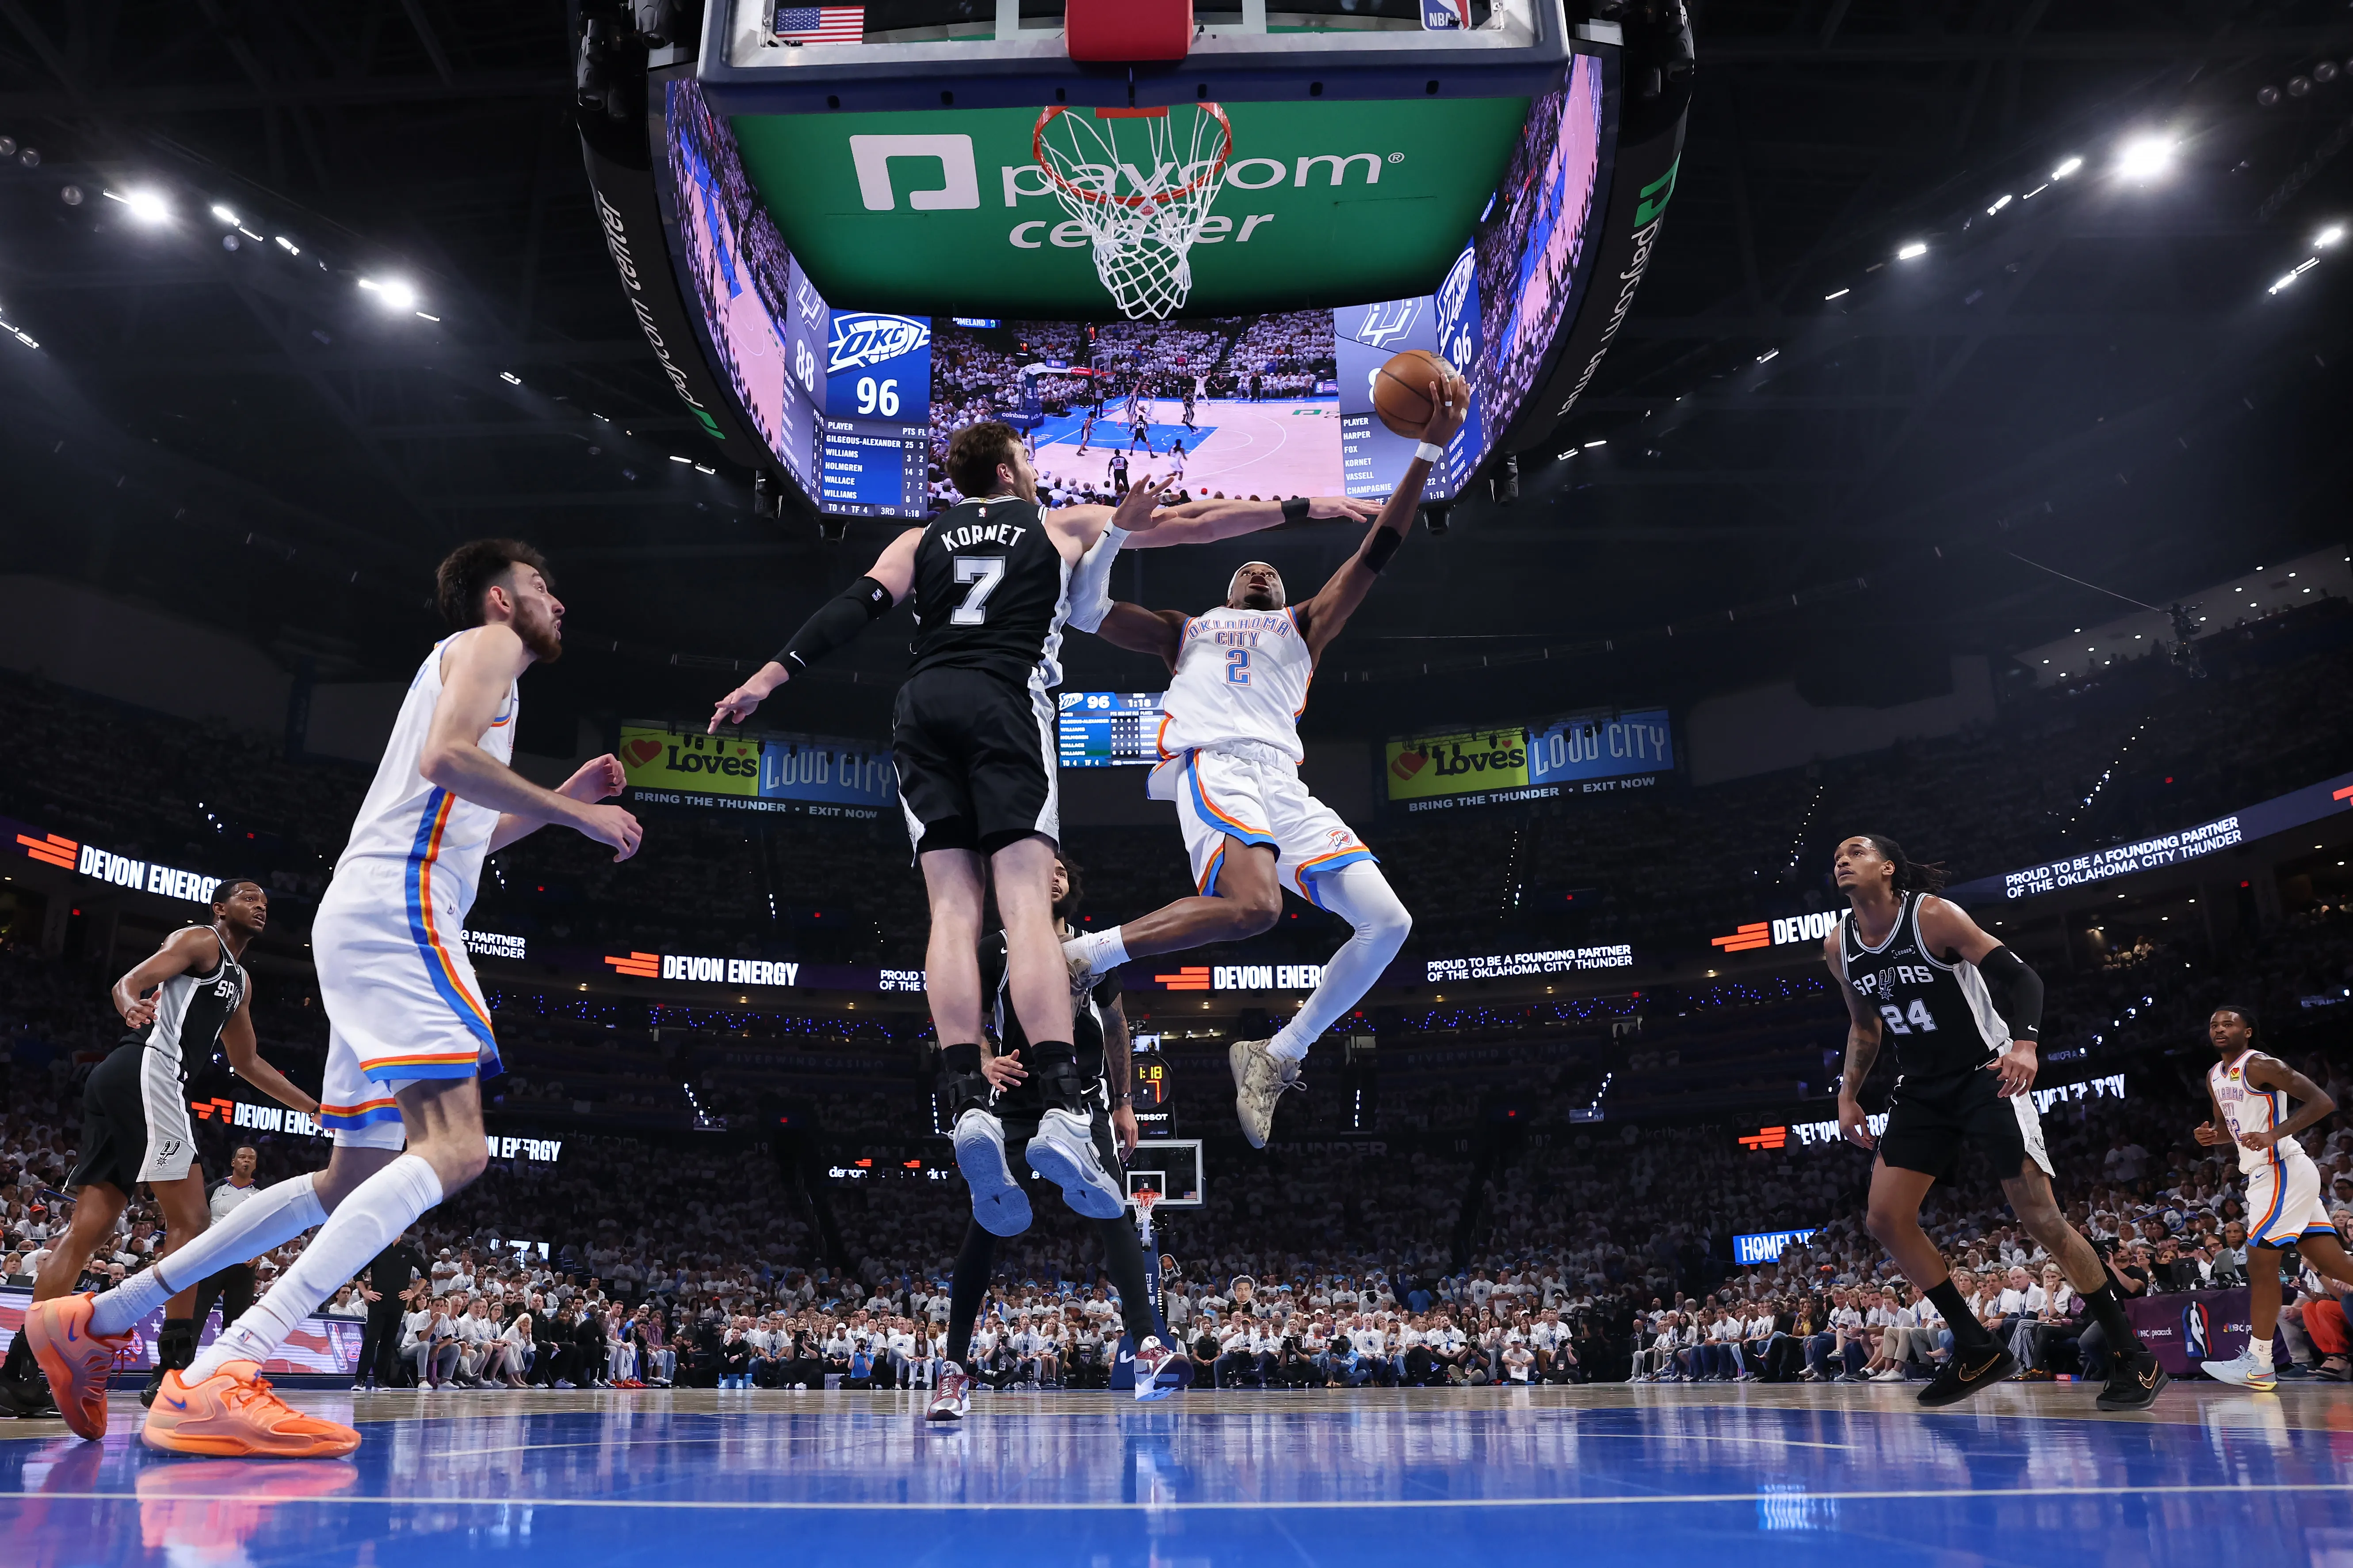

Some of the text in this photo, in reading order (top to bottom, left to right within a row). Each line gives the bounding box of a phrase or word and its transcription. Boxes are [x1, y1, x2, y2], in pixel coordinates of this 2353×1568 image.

[598, 191, 703, 408] paycom center
[1557, 218, 1660, 416] paycom center
[1453, 322, 1472, 376] 96
[796, 339, 814, 392] 88
[856, 377, 900, 416] 96
[828, 421, 853, 431] PLAYER
[1343, 417, 1369, 427] PLAYER
[826, 435, 901, 448] GILGEOUS-ALEXANDER
[1343, 431, 1371, 440] HARPER
[825, 448, 858, 458] WILLIAMS
[1344, 445, 1358, 454] FOX
[825, 462, 863, 472] HOLMGREN
[1345, 458, 1371, 467] KORNET
[825, 475, 855, 485] WALLACE
[1346, 471, 1374, 481] VASSELL
[824, 489, 857, 499] WILLIAMS
[1347, 483, 1392, 495] CHAMPAGNIE
[1427, 477, 1436, 486] 22
[1429, 490, 1445, 500] 1:18
[828, 503, 837, 511] TO
[851, 505, 860, 514] TF
[881, 507, 895, 515] 3RD
[905, 509, 920, 518] 1:18
[941, 523, 1027, 552] KORNET
[950, 556, 1006, 625] 7
[1187, 615, 1291, 640] OKLAHOMA
[1215, 630, 1260, 647] CITY
[1225, 648, 1251, 686] 2
[1087, 695, 1110, 709] 96
[1127, 698, 1151, 708] 1:18
[1533, 726, 1598, 777] LOUD
[1608, 723, 1665, 762] CITY
[766, 751, 829, 790] LOUD
[839, 752, 891, 799] CITY
[1409, 776, 1655, 813] BRING THE THUNDER EXIT NOW
[634, 791, 878, 819] BRING THE THUNDER EXIT NOW
[1333, 832, 1347, 847] OKC
[2005, 816, 2240, 887] PROUD TO BE A FOUNDING PARTNER
[2007, 829, 2243, 899] OF THE OKLAHOMA CITY THUNDER
[79, 845, 222, 905] DEVON ENERG
[1772, 911, 1837, 945] DEVON
[472, 931, 526, 949] PARTNER
[469, 941, 526, 959] THUNDER
[1427, 944, 1631, 972] PROUD TO BE A FOUNDING PARTNER
[1895, 948, 1912, 956] LEDGER
[663, 954, 798, 987] DEVON ENERGY
[880, 969, 918, 981] PROUD
[1214, 965, 1327, 990] DEVON ENER
[1427, 955, 1633, 982] OF THE OKLAHOMA CITY THUNDER
[879, 980, 921, 992] OF THE
[1879, 998, 1938, 1035] 24
[1139, 1066, 1162, 1080] 1:18
[1146, 1080, 1161, 1103] 7
[234, 1102, 283, 1132] DEVON
[2152, 1327, 2173, 1339] peacock
